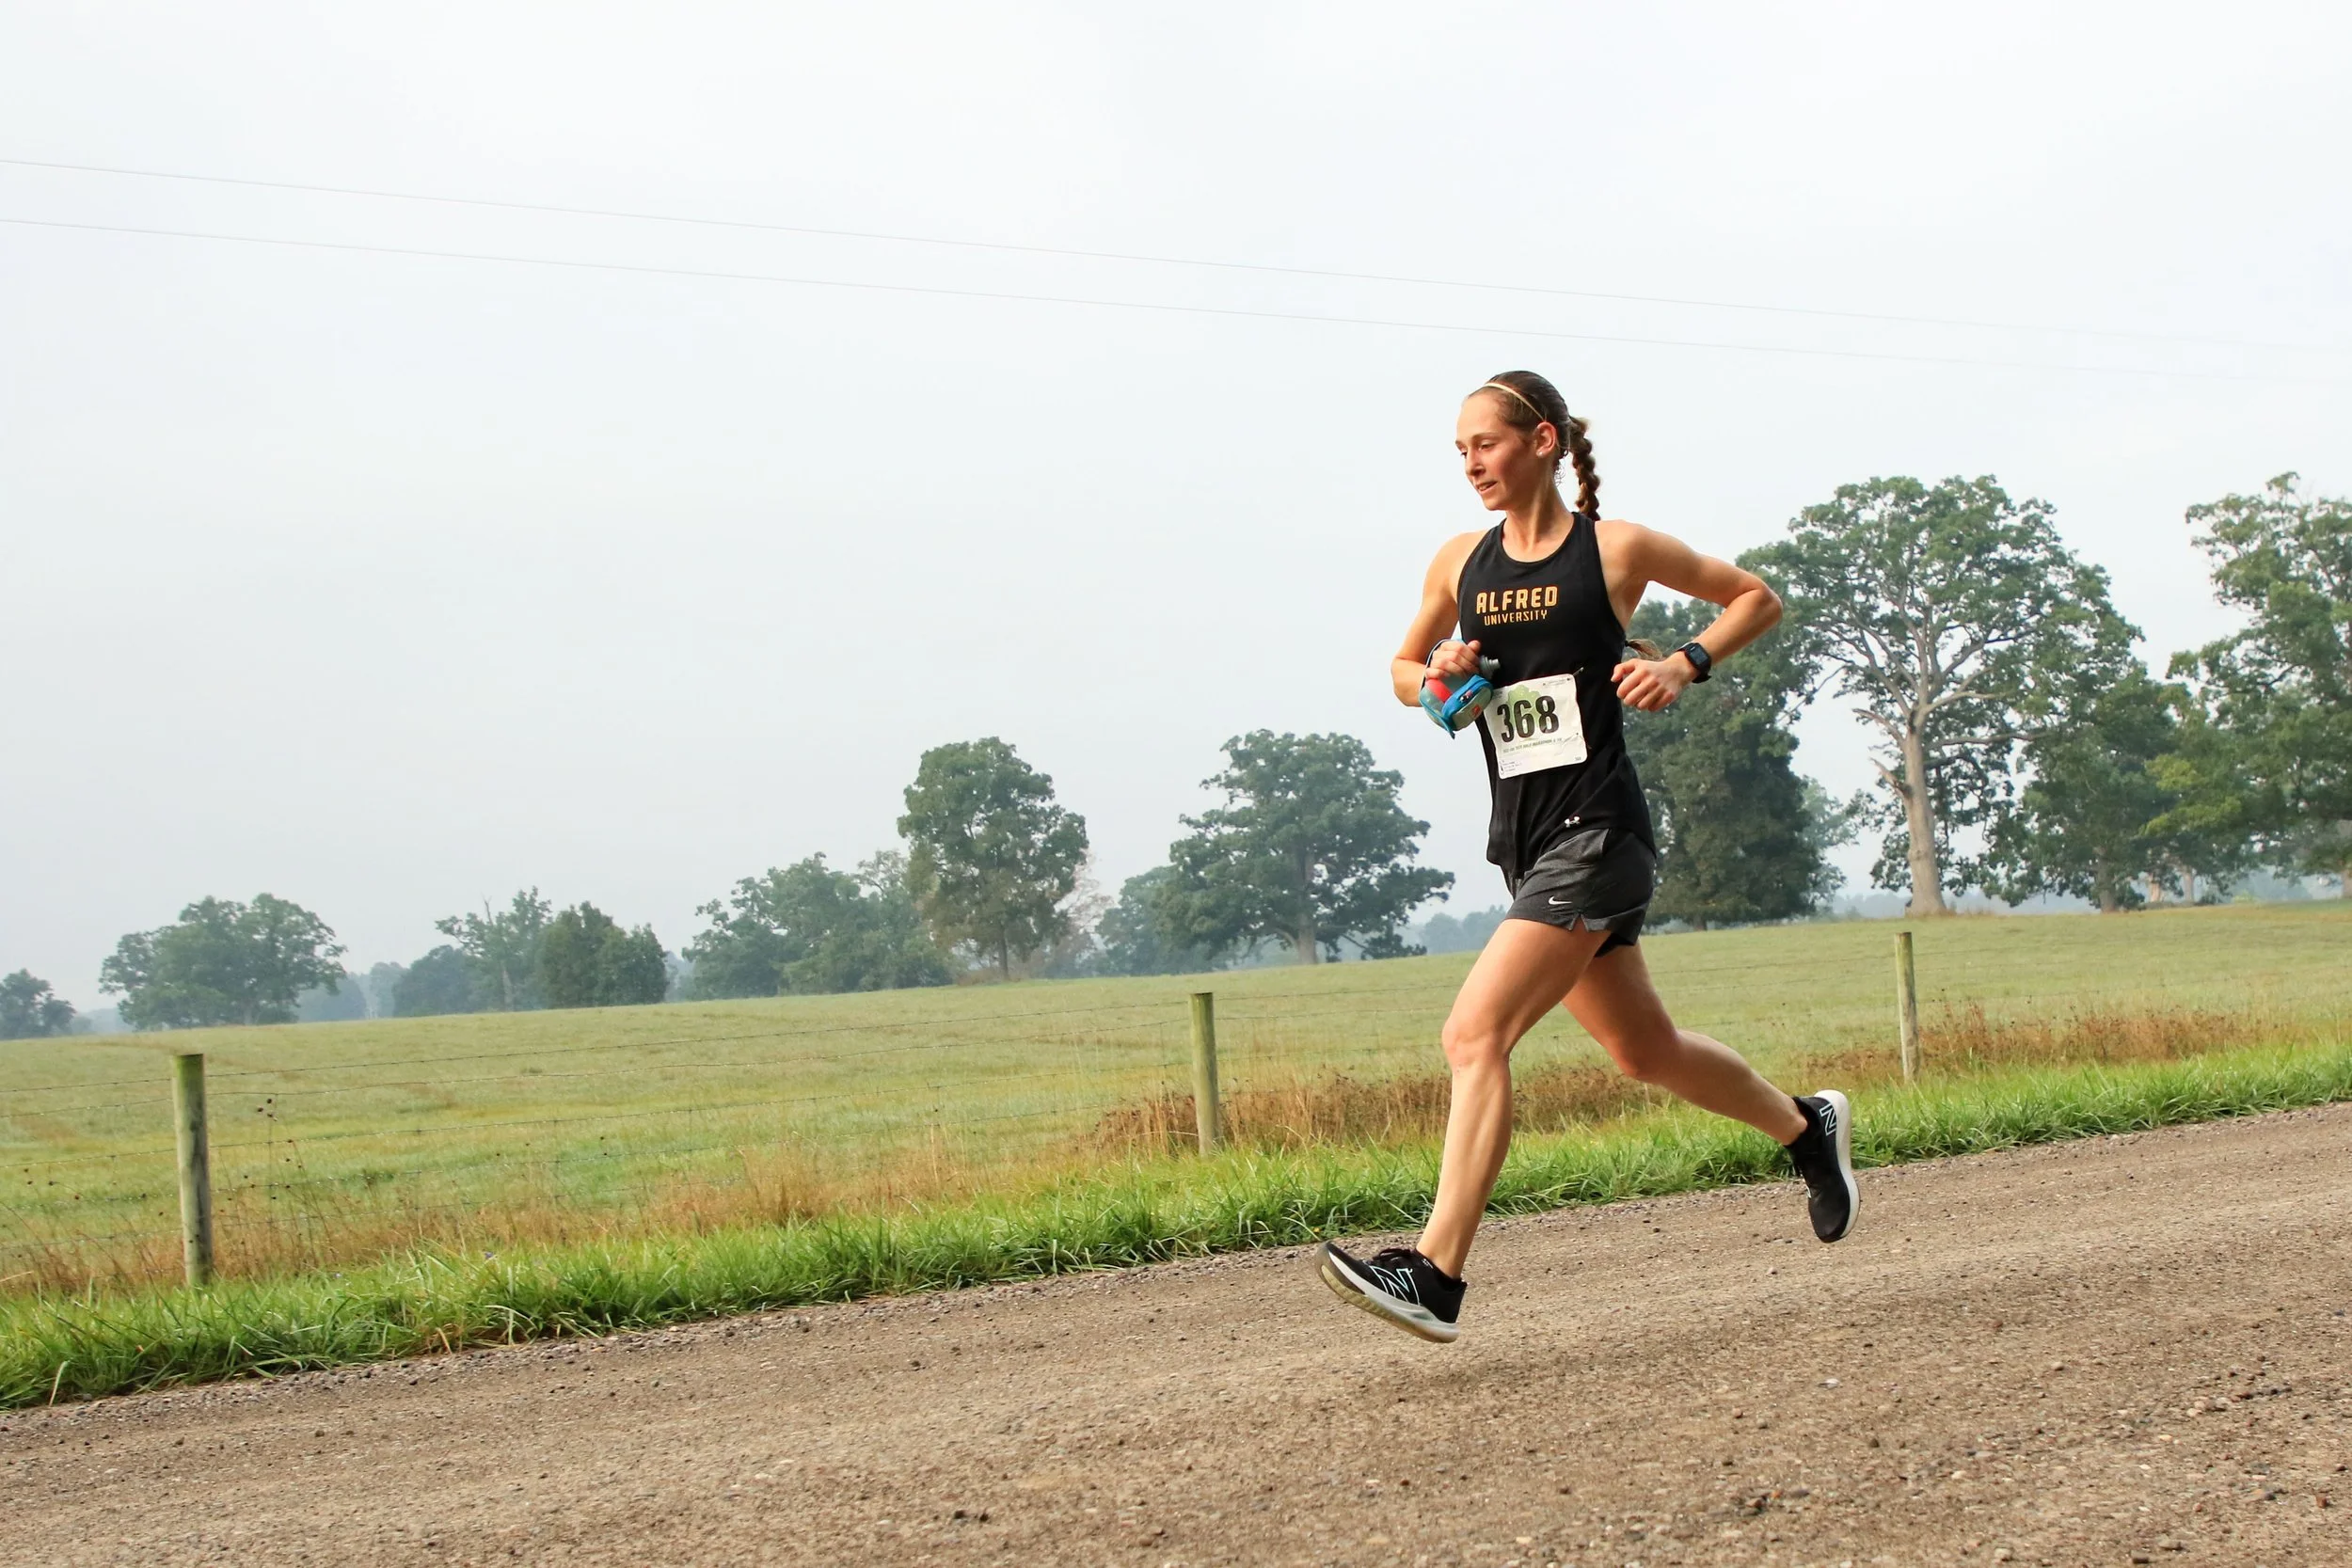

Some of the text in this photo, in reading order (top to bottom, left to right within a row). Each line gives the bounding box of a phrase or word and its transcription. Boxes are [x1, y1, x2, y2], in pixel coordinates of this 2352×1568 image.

[1476, 586, 1558, 614] ALFRED
[1484, 610, 1548, 626] UNIVERSITY
[1497, 695, 1560, 743] 368
